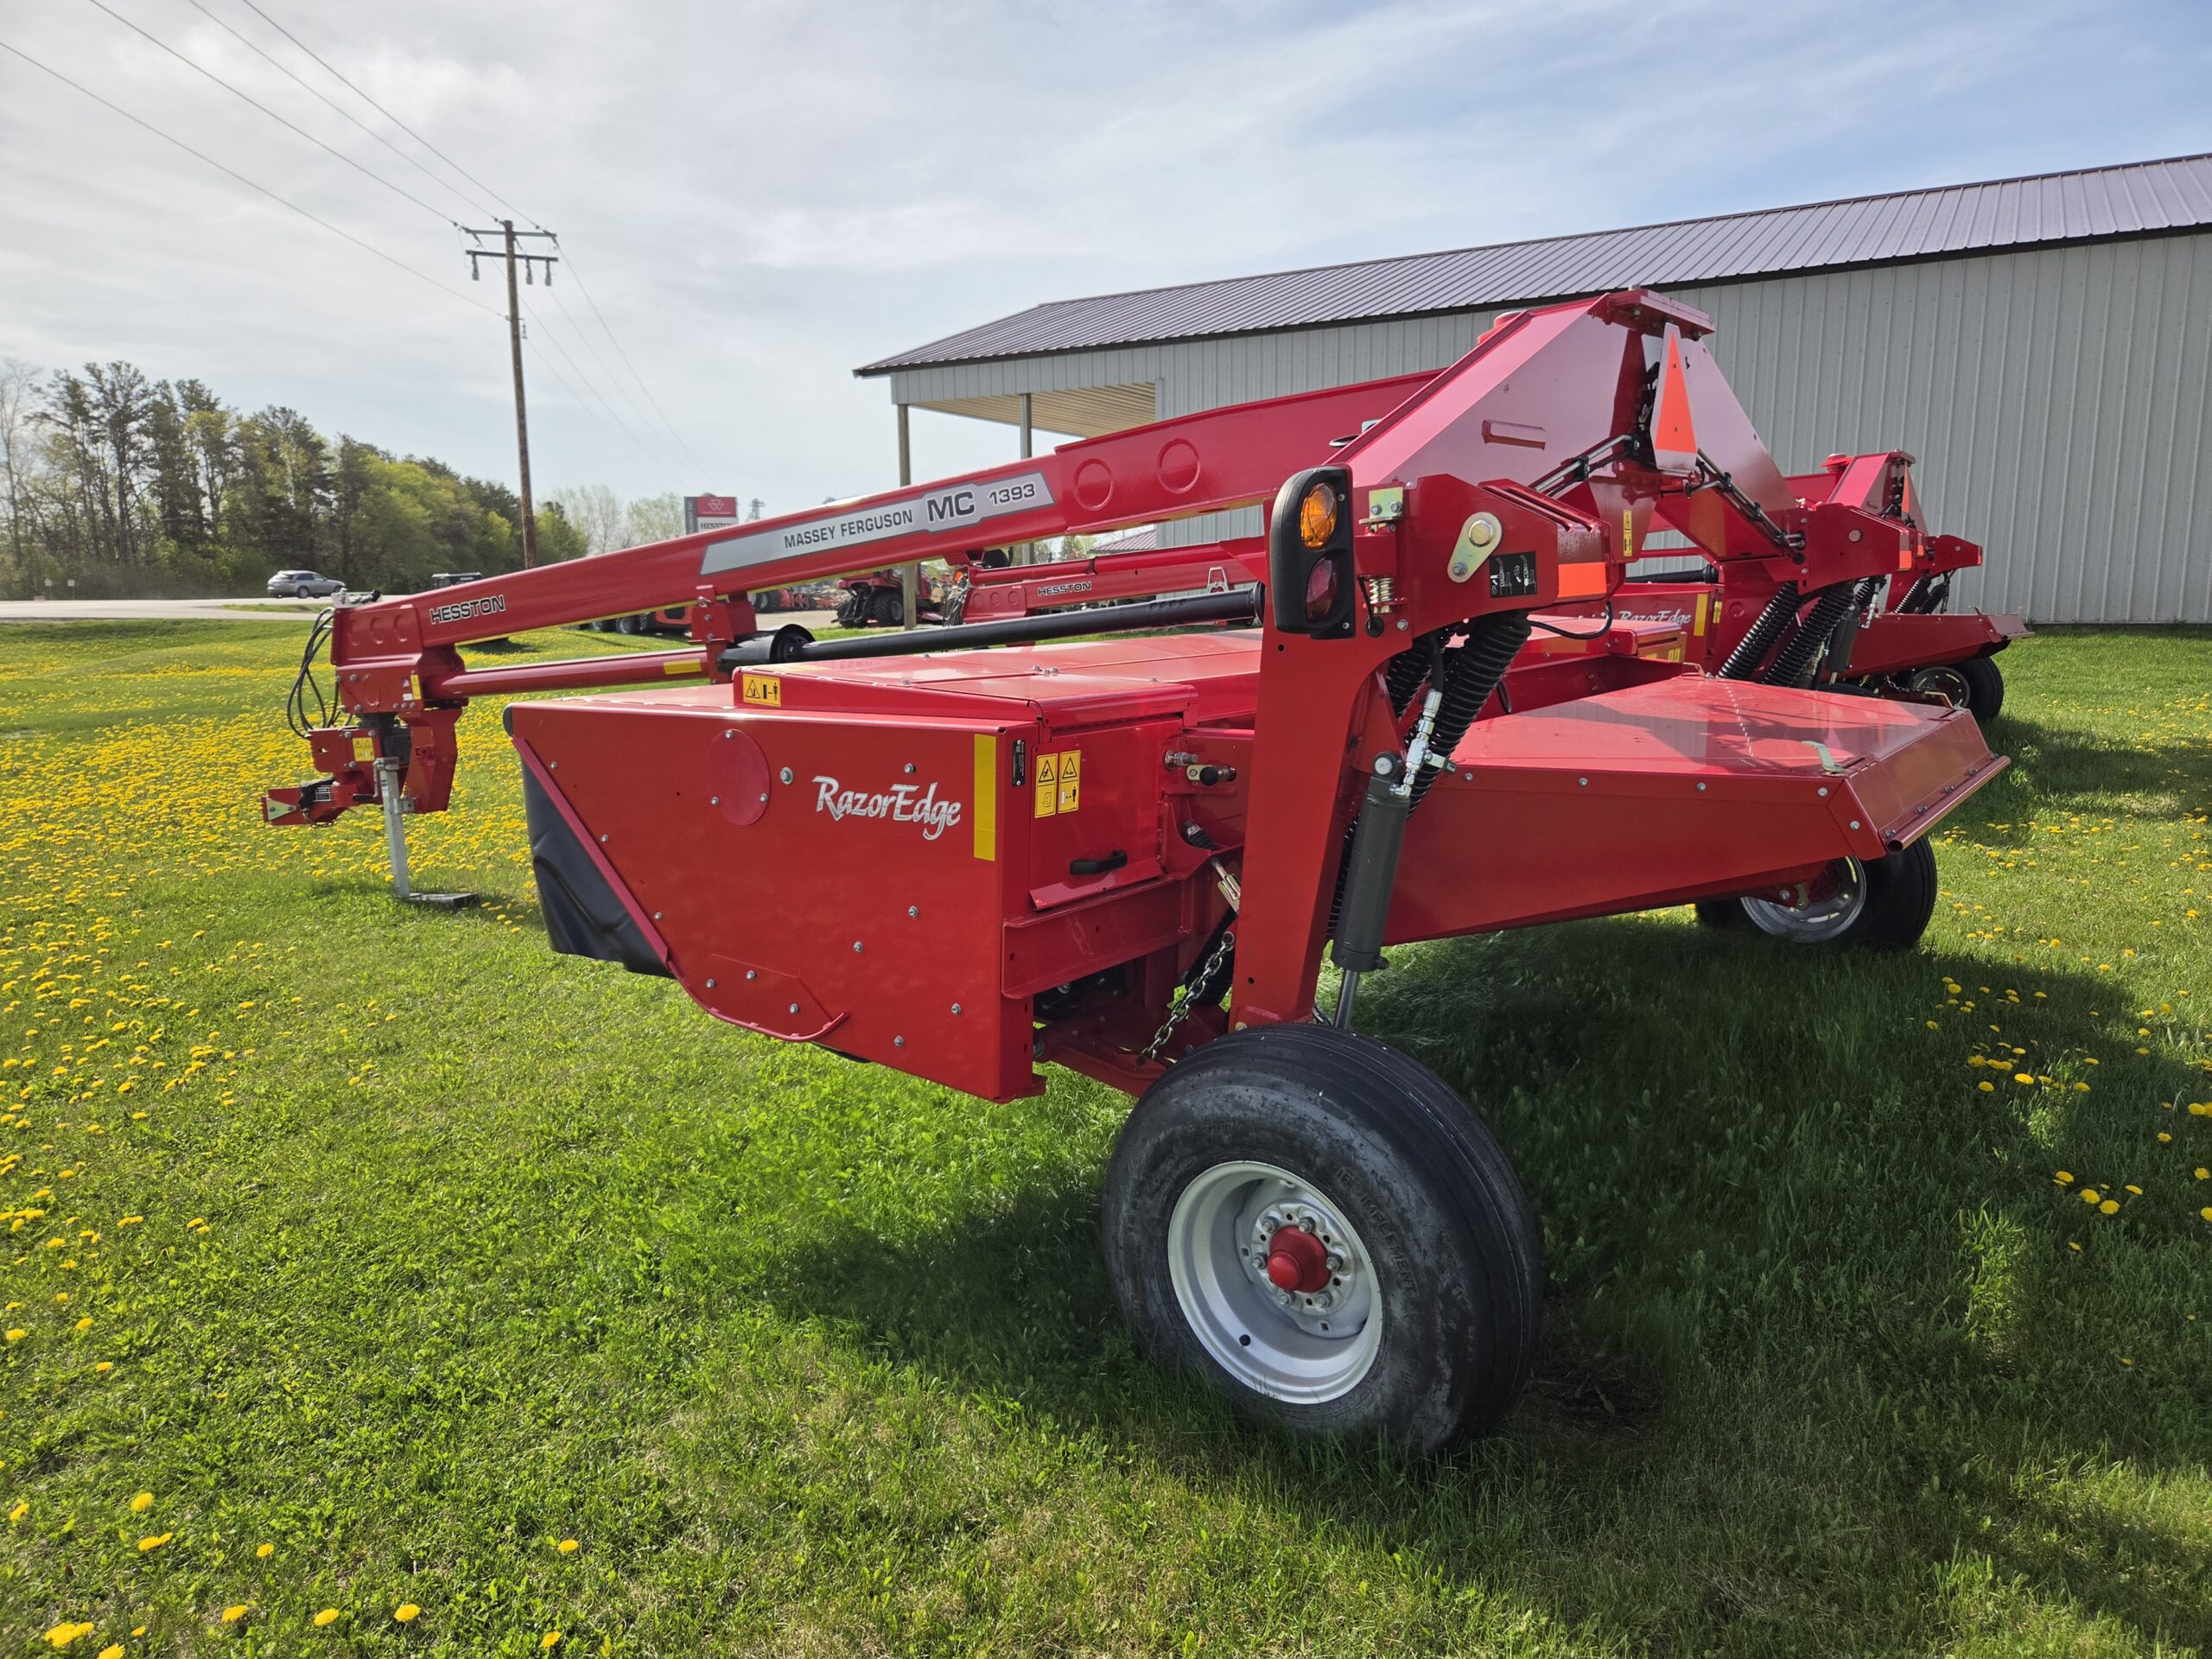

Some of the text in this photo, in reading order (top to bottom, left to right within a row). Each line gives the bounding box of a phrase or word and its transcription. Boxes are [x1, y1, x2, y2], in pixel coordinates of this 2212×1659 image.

[784, 484, 1035, 549] MASSEY FERGUSON MC 1393
[429, 594, 505, 624] HESSTON
[1038, 581, 1092, 596] HESSTON
[812, 775, 962, 840] RazorEdge
